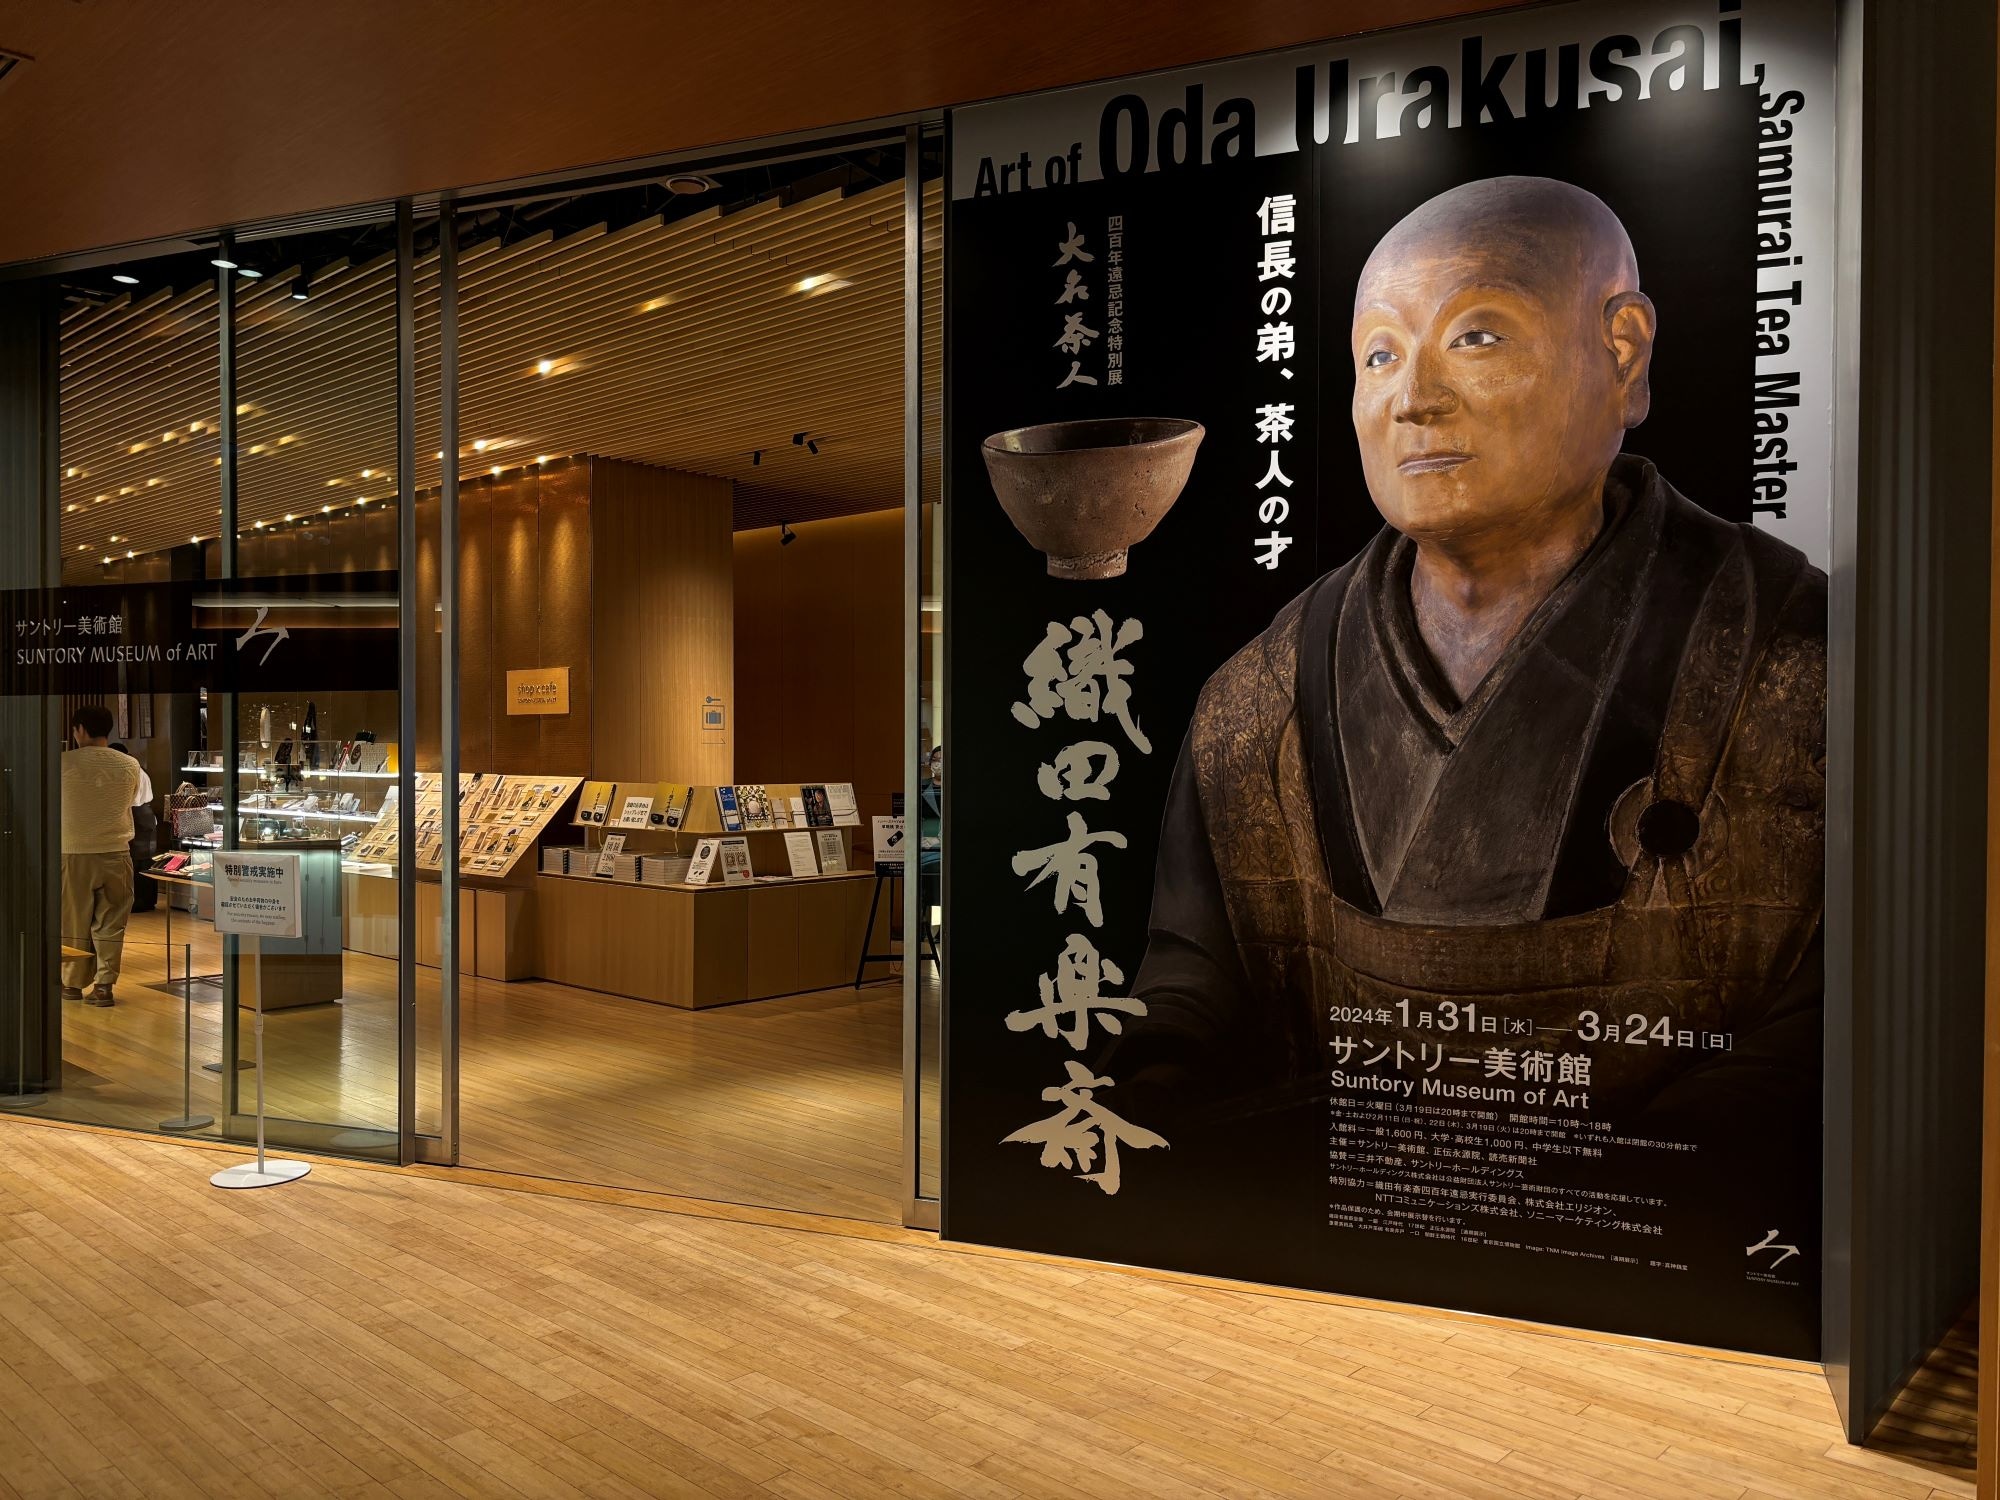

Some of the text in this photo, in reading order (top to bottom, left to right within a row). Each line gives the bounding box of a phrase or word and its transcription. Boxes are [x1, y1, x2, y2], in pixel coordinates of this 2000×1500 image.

[974, 151, 1032, 199] Art
[1044, 142, 1083, 189] of
[1099, 83, 1257, 181] Oda
[1107, 215, 1123, 386] 四百年遠忌記念特別展
[1752, 90, 1805, 520] Samurai Tea Master
[1255, 194, 1297, 570] 信長の弟、茶人の才
[15, 614, 124, 637] サントリー美術館
[17, 643, 218, 665] SUNTORY MUSEUM of ART
[1328, 1035, 1593, 1087] サントリー美術館
[1330, 1069, 1590, 1110] Suntory Museum of Art
